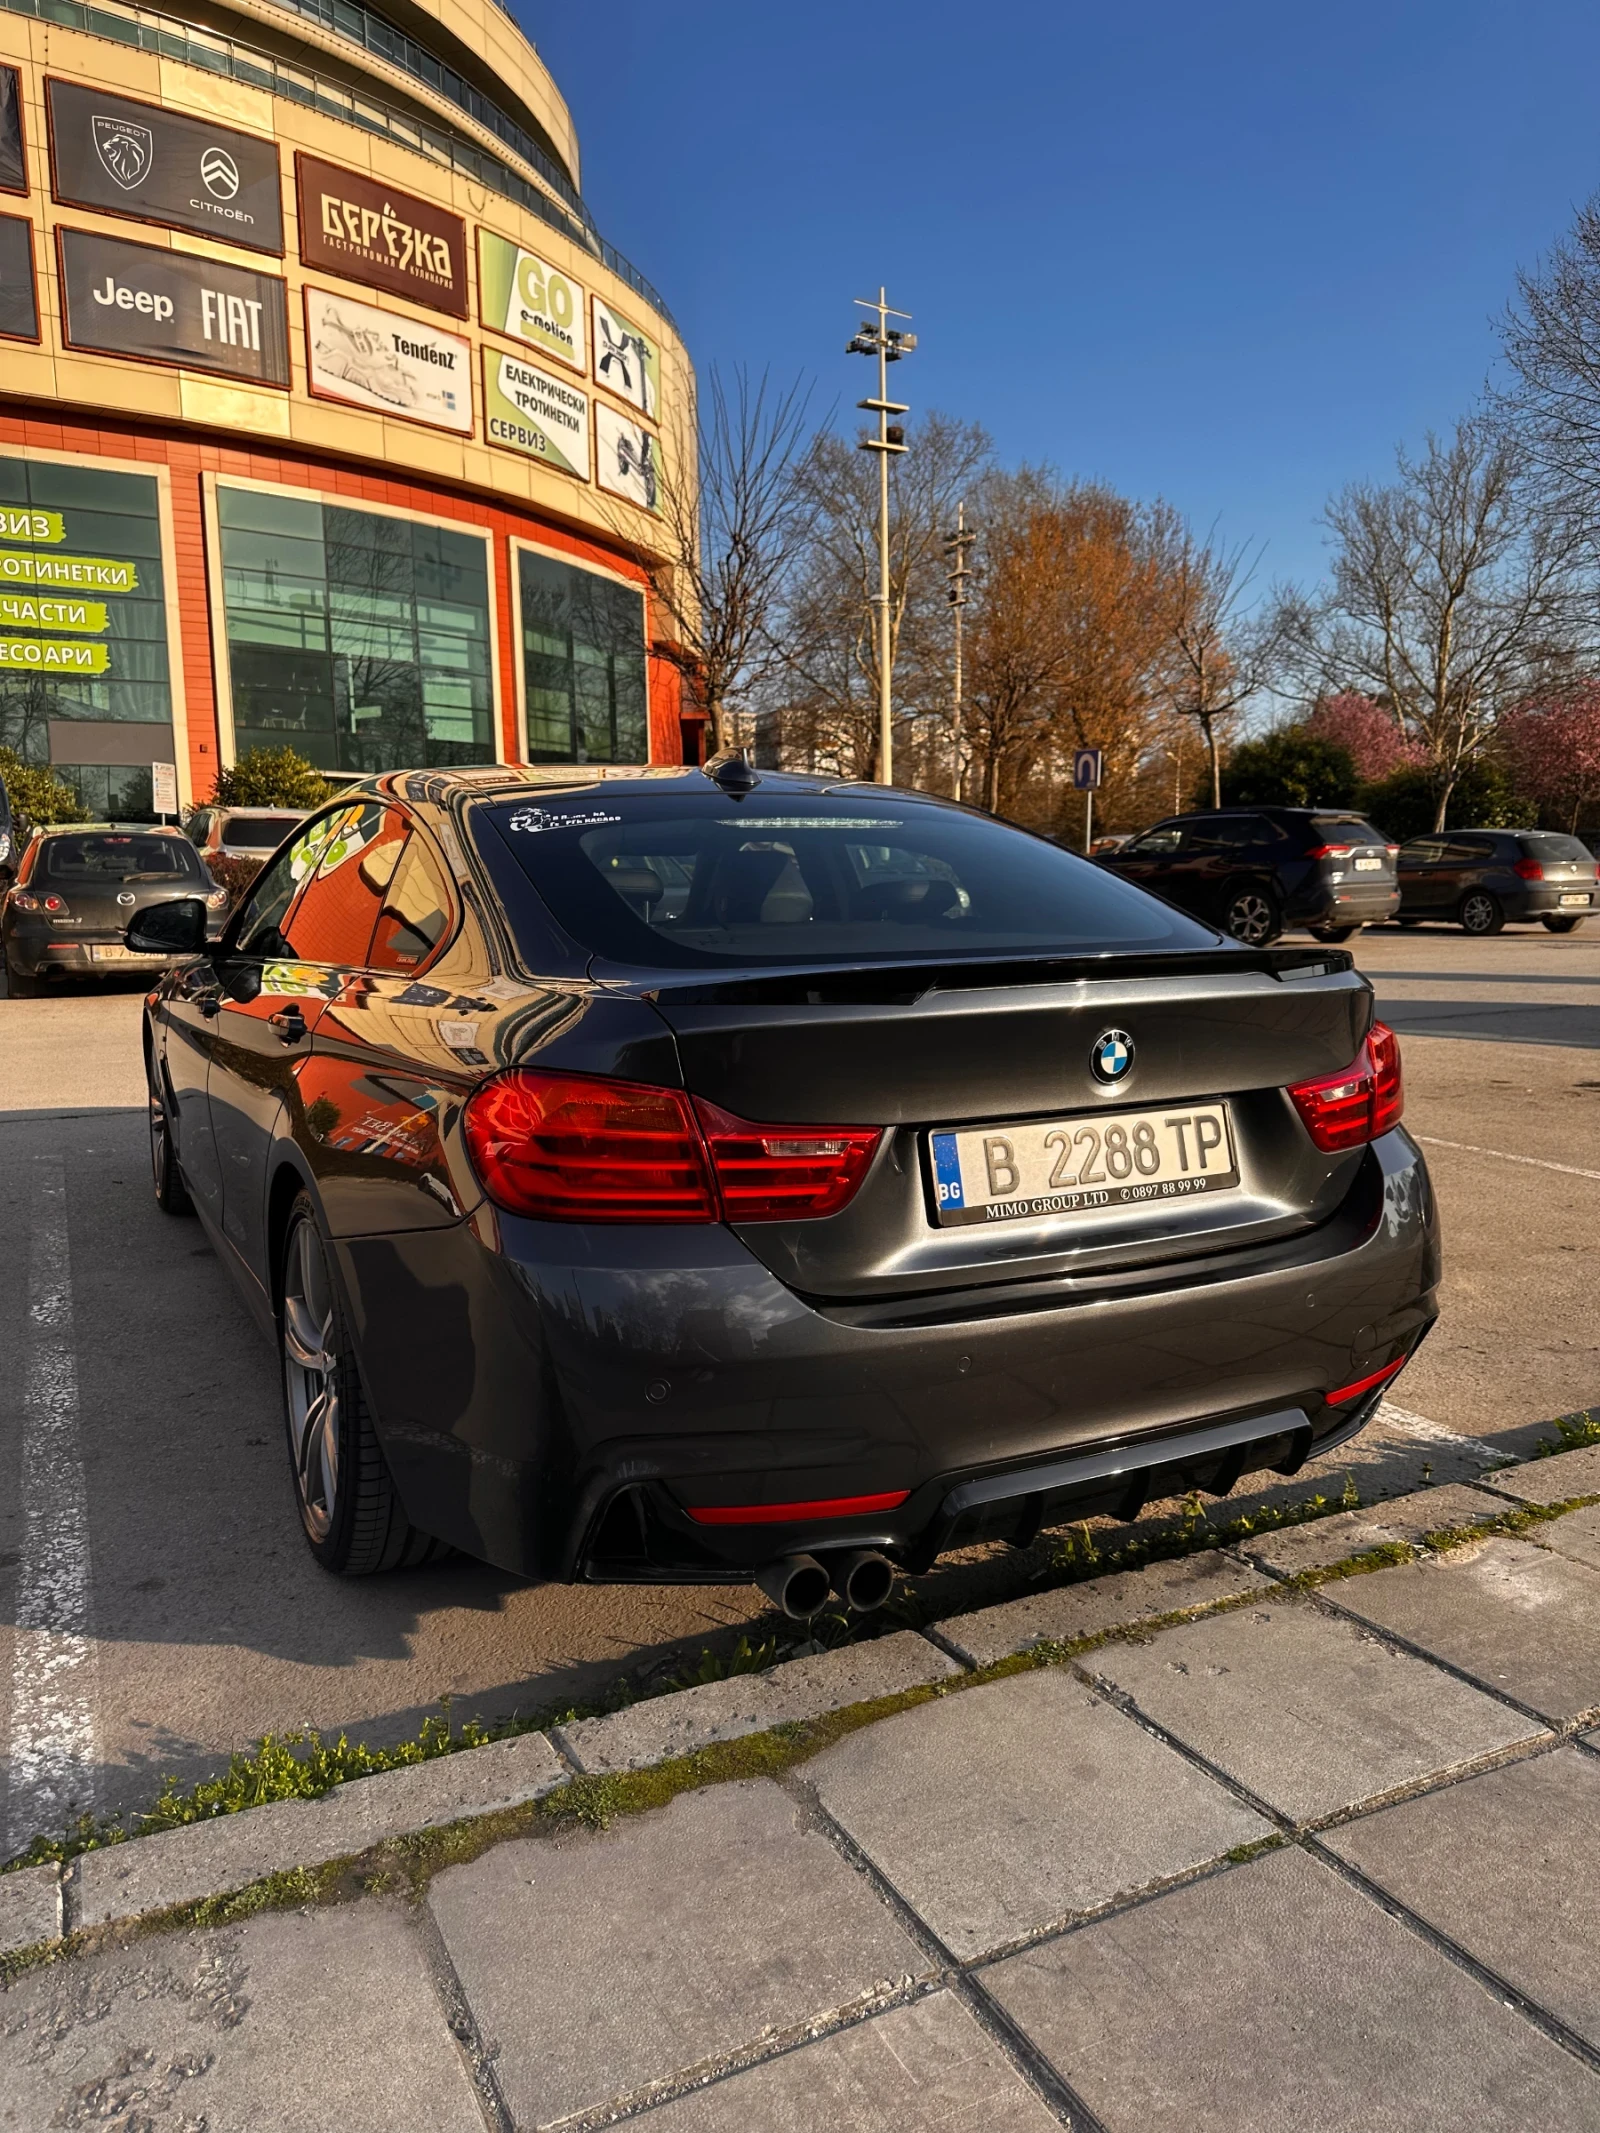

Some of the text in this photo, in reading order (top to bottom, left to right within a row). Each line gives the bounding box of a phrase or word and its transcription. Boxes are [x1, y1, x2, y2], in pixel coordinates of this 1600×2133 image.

[97, 120, 148, 139] PEUGEOT
[323, 235, 454, 290] ГАСТРОНОМИЯ КУЛИНАРИЯ
[93, 277, 173, 321] Jeep
[518, 257, 574, 329] GO
[201, 288, 263, 351] FIAT
[520, 309, 574, 346] e-motion
[391, 333, 455, 370] TendenZ
[505, 363, 585, 415] ЕЛЕКТРИЧЕСКИ
[515, 389, 580, 433] ТРОТИНЕТКИ
[490, 418, 546, 452] СЕРВИЗ
[0, 558, 128, 586] ОТИНЕТКИ
[1096, 1031, 1133, 1051] BMW
[983, 1114, 1222, 1197] B 2288 TP
[938, 1182, 961, 1200] BG
[985, 1178, 1207, 1219] MIMO GROUP LTD 0897 88 99 99
